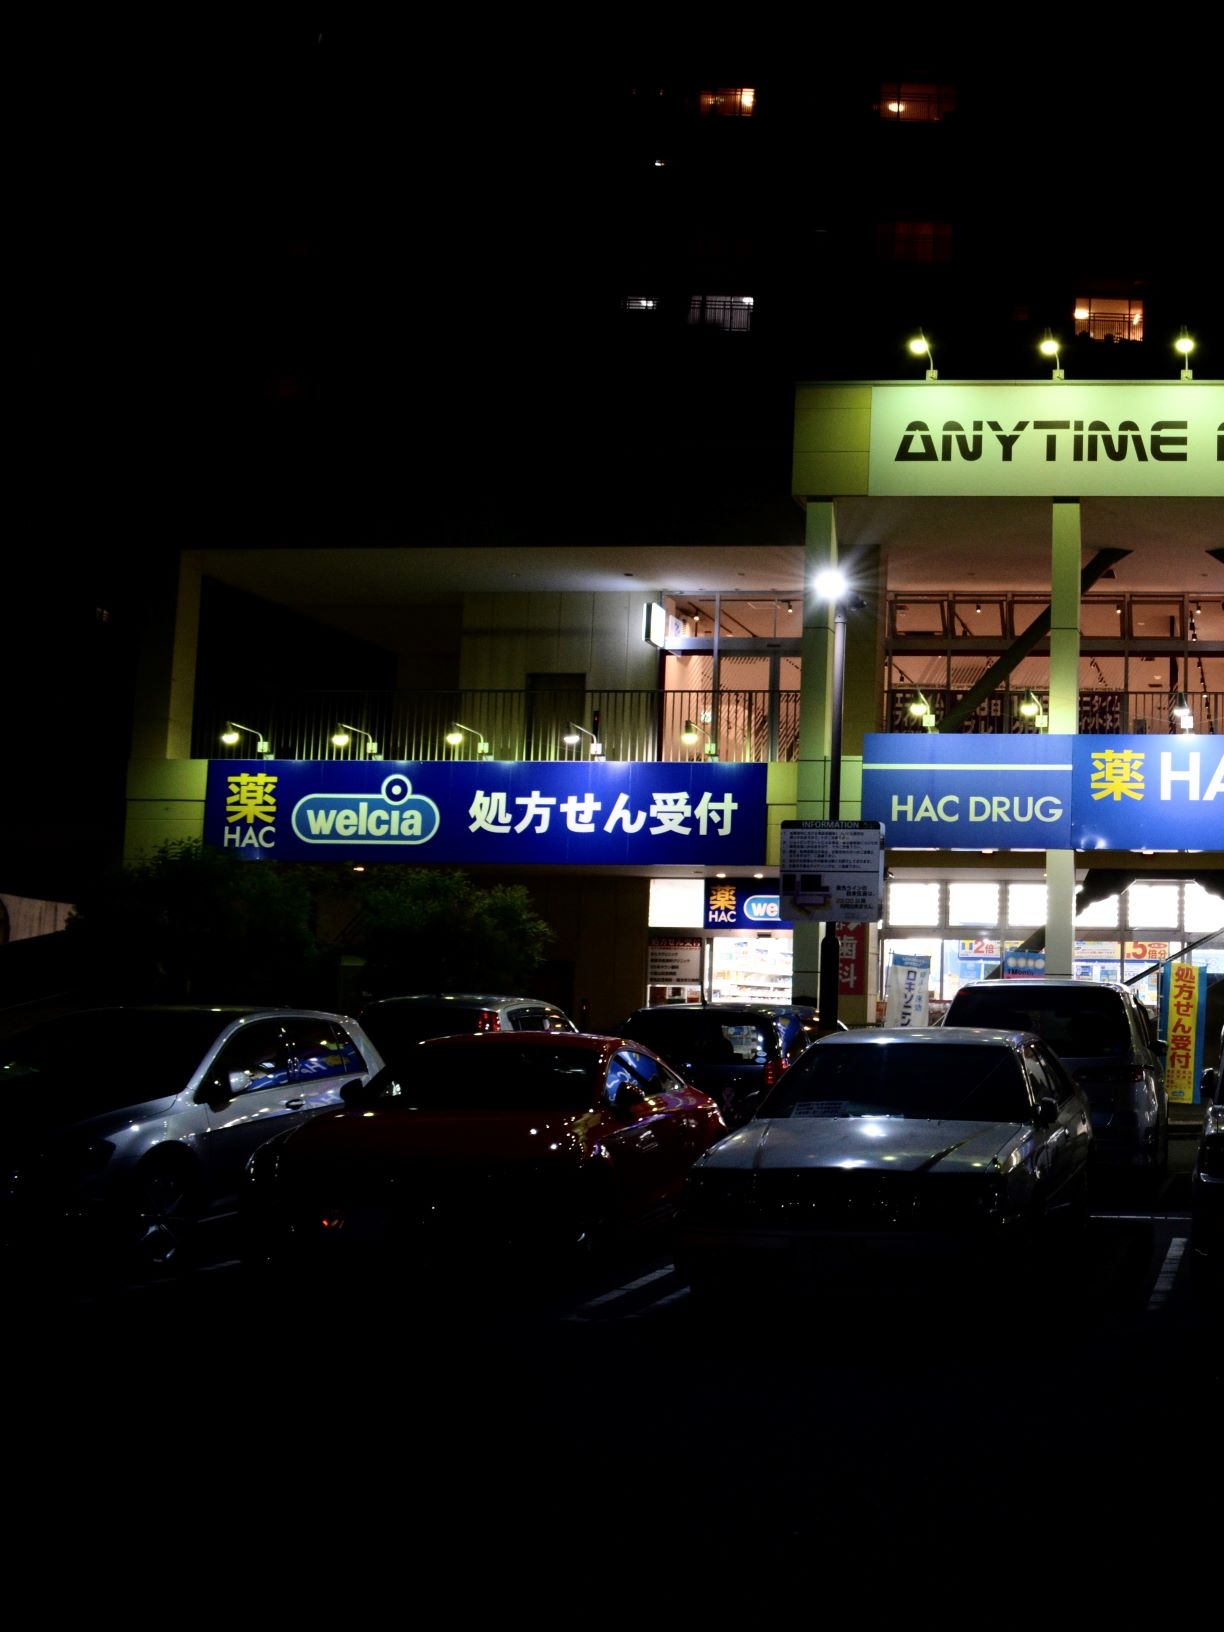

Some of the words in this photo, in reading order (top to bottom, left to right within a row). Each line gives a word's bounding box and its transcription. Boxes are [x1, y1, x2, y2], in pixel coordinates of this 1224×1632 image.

[894, 420, 1188, 462] ANYTIME
[1090, 749, 1145, 801] 薬
[226, 773, 278, 824] 薬
[468, 790, 739, 836] 処方せん受付
[891, 795, 959, 822] HAC
[969, 796, 1063, 824] DRUG
[223, 826, 276, 848] HAC
[306, 802, 423, 837] welcia
[801, 821, 859, 829] INFORMATION
[709, 885, 737, 911] 薬
[708, 911, 737, 923] HAC
[1169, 966, 1196, 1070] 処方せん受付
